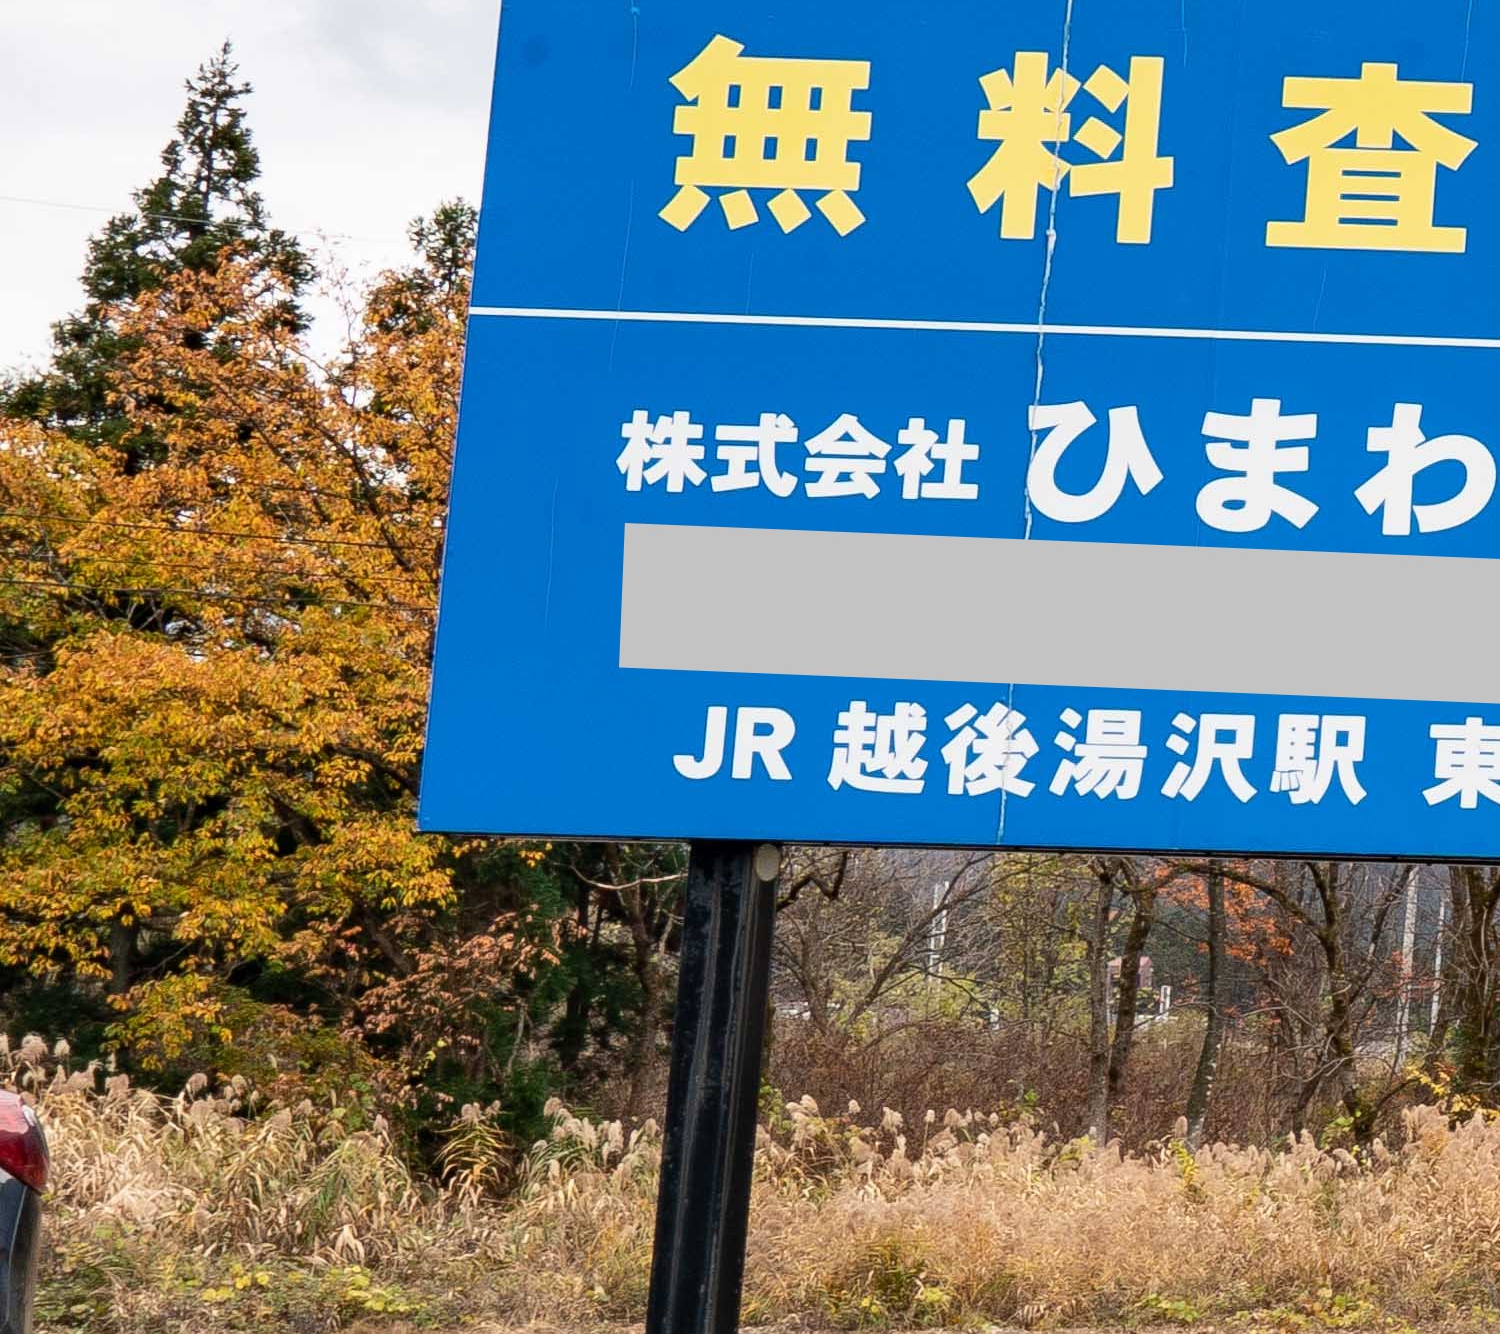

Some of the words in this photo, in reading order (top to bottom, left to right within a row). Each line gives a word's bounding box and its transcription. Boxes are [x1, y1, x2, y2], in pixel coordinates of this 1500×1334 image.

[616, 410, 979, 500] 株式会社
[673, 706, 796, 780] JR
[832, 701, 1367, 805] 越後湯沢駅
